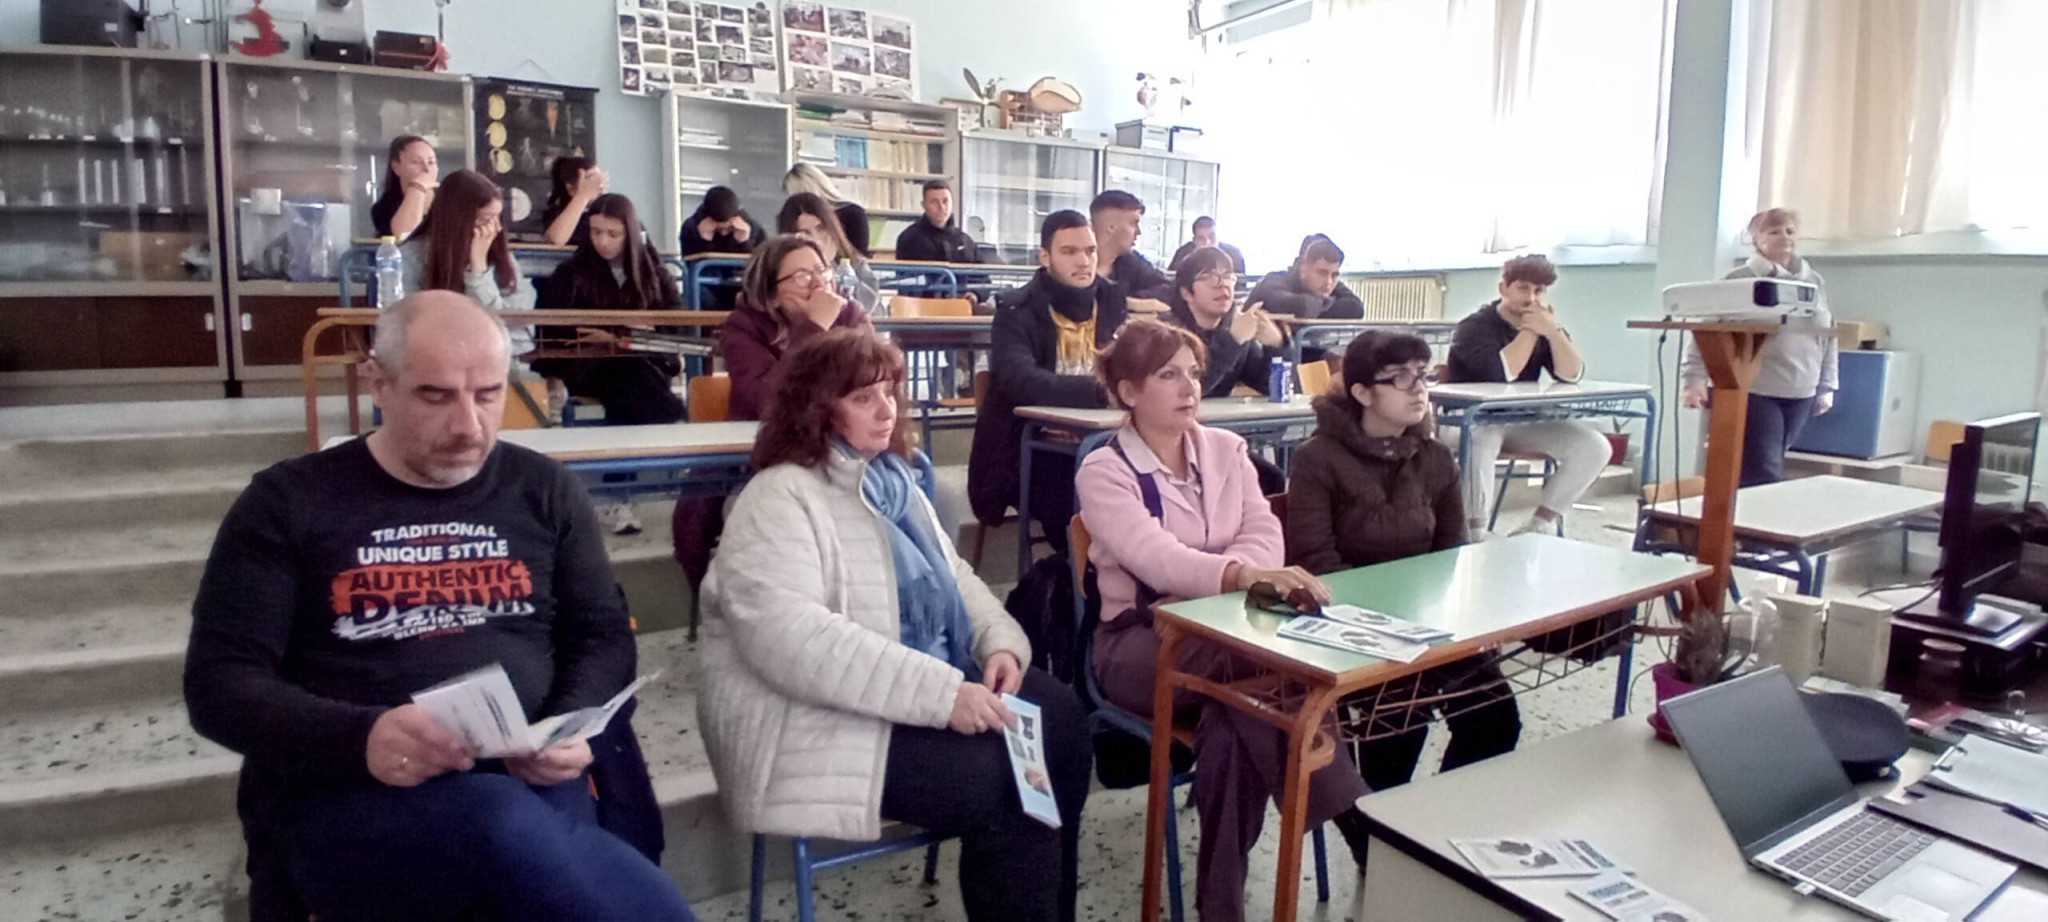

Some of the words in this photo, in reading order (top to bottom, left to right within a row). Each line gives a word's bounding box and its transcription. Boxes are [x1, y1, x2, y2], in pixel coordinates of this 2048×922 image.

[371, 522, 498, 543] TRADITIONAL
[357, 545, 443, 565] UNIQUE
[448, 539, 509, 559] STYLE
[350, 561, 522, 592] AUTHENTIC
